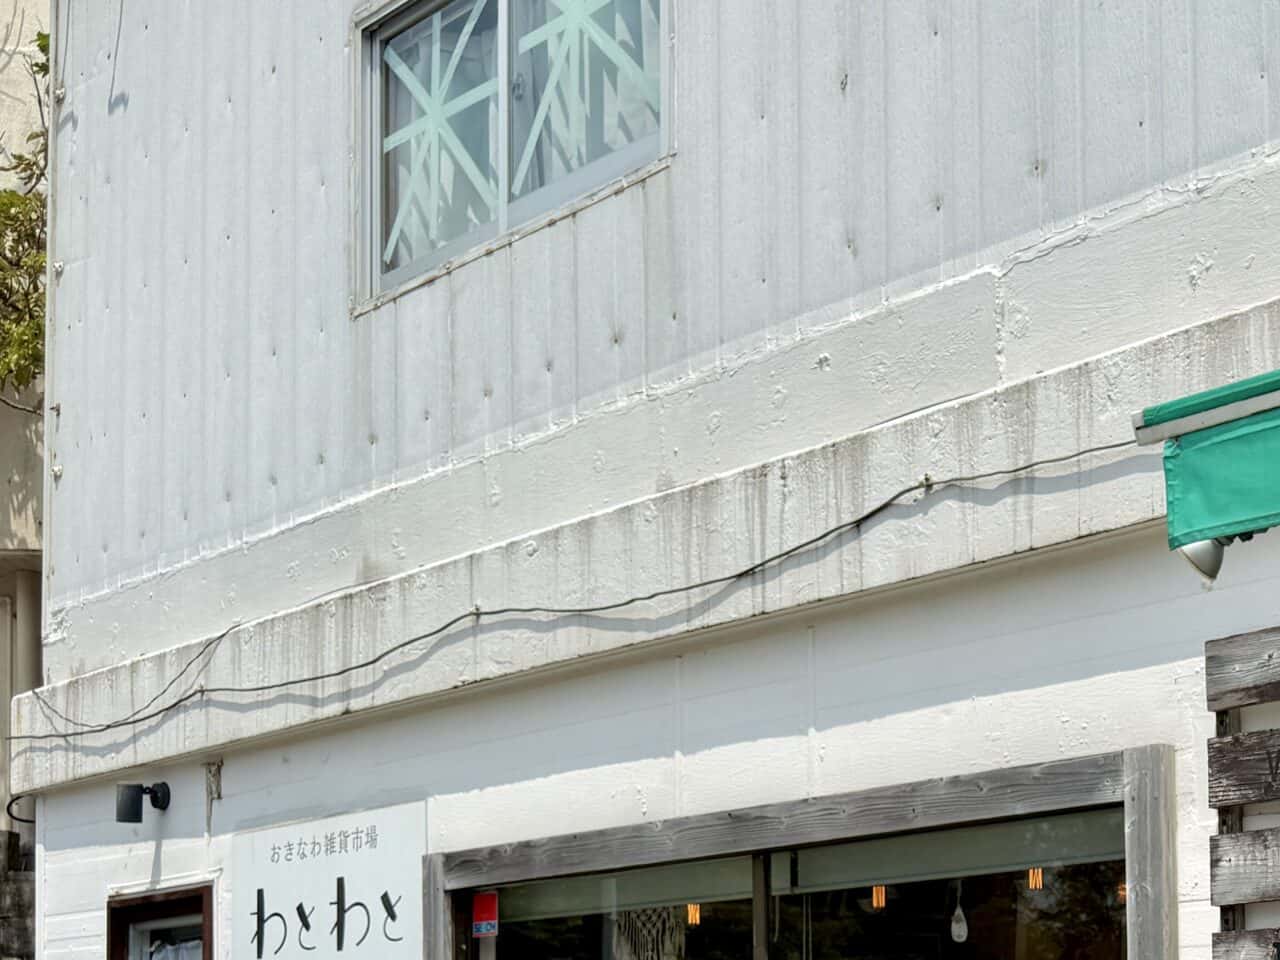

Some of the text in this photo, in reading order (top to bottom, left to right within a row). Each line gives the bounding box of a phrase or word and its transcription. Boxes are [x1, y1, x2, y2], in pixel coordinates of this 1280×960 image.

[270, 824, 379, 864] おきなわ雑貨市場
[250, 876, 403, 960] わとわと
